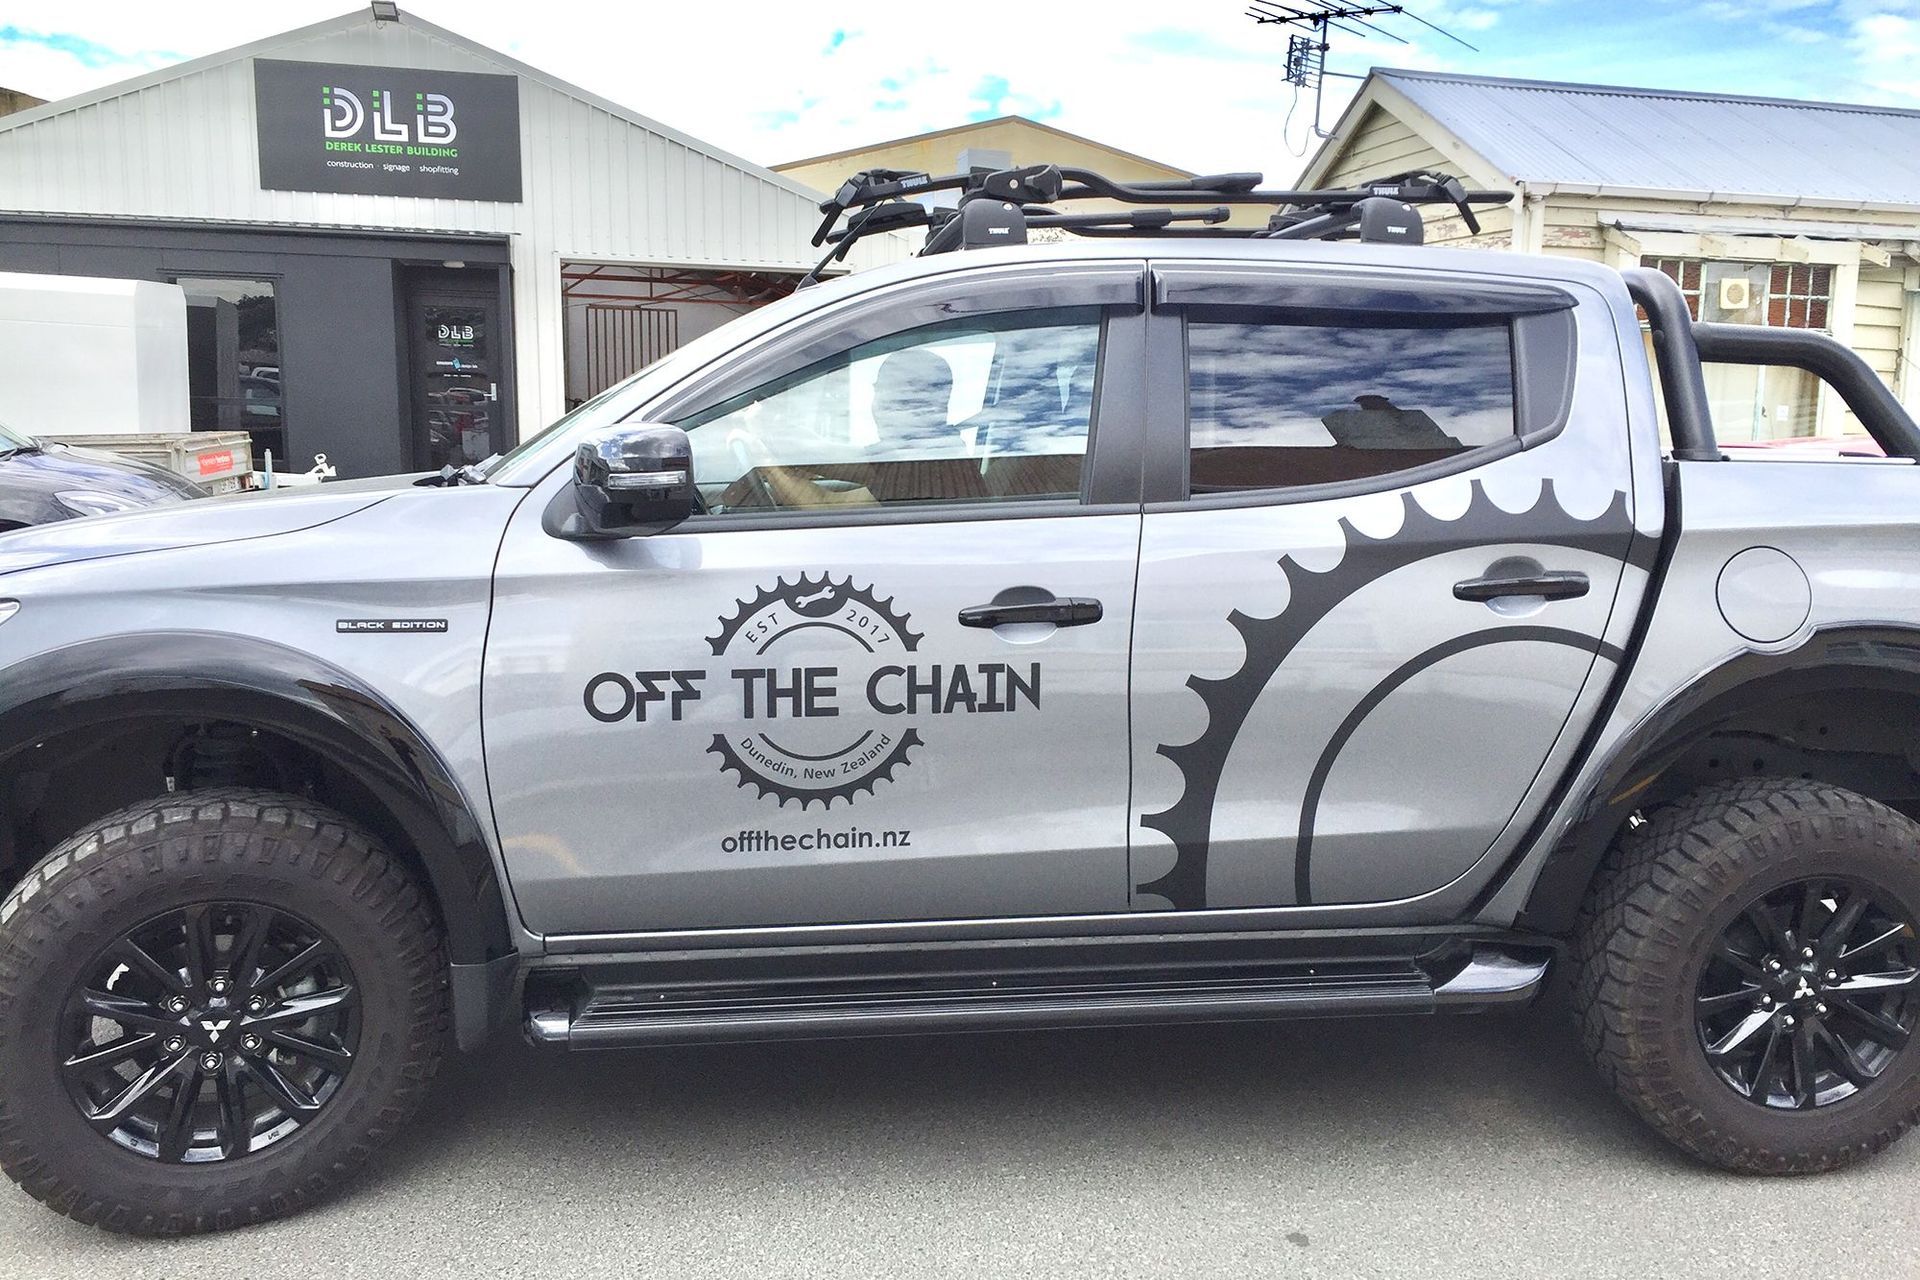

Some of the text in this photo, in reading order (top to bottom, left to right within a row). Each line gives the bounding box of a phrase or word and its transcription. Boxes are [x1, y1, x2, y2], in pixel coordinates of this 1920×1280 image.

[323, 86, 458, 145] DLB
[325, 141, 459, 158] DEREK LESTER BUILDING
[326, 160, 460, 175] construction signage shopfitting
[901, 176, 928, 188] THULE
[1373, 187, 1399, 195] THULE
[988, 227, 1010, 235] THULE
[1387, 226, 1408, 234] THULE
[438, 324, 474, 340] DLB
[338, 621, 446, 629] BLACK EDITION
[745, 609, 890, 644] EST 2017
[583, 662, 1041, 723] OFF THE CHAIN
[740, 733, 892, 780] Dunedin, New Zealand
[721, 828, 911, 854] offthechain.nz
